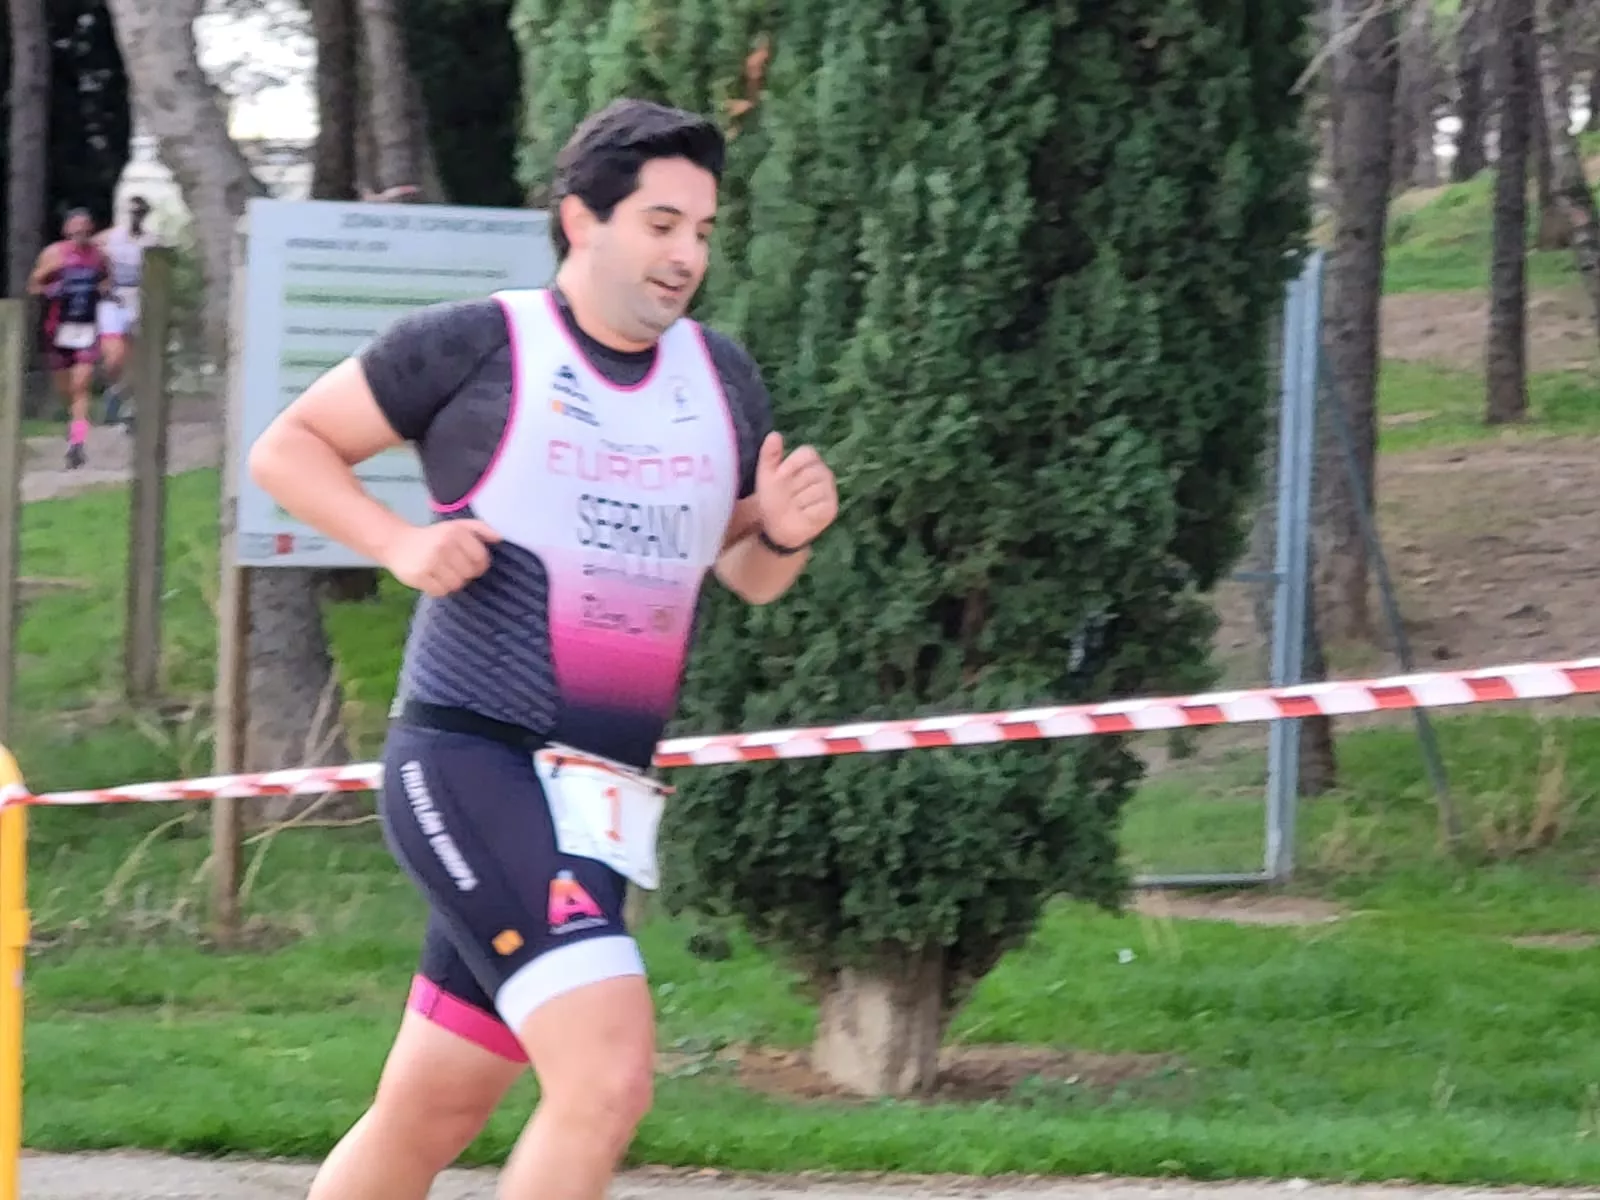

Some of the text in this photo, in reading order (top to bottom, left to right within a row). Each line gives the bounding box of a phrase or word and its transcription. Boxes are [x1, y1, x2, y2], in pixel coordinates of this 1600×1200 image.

[546, 439, 716, 490] EUROPA
[576, 492, 693, 560] SERRANO
[601, 786, 625, 842] 1
